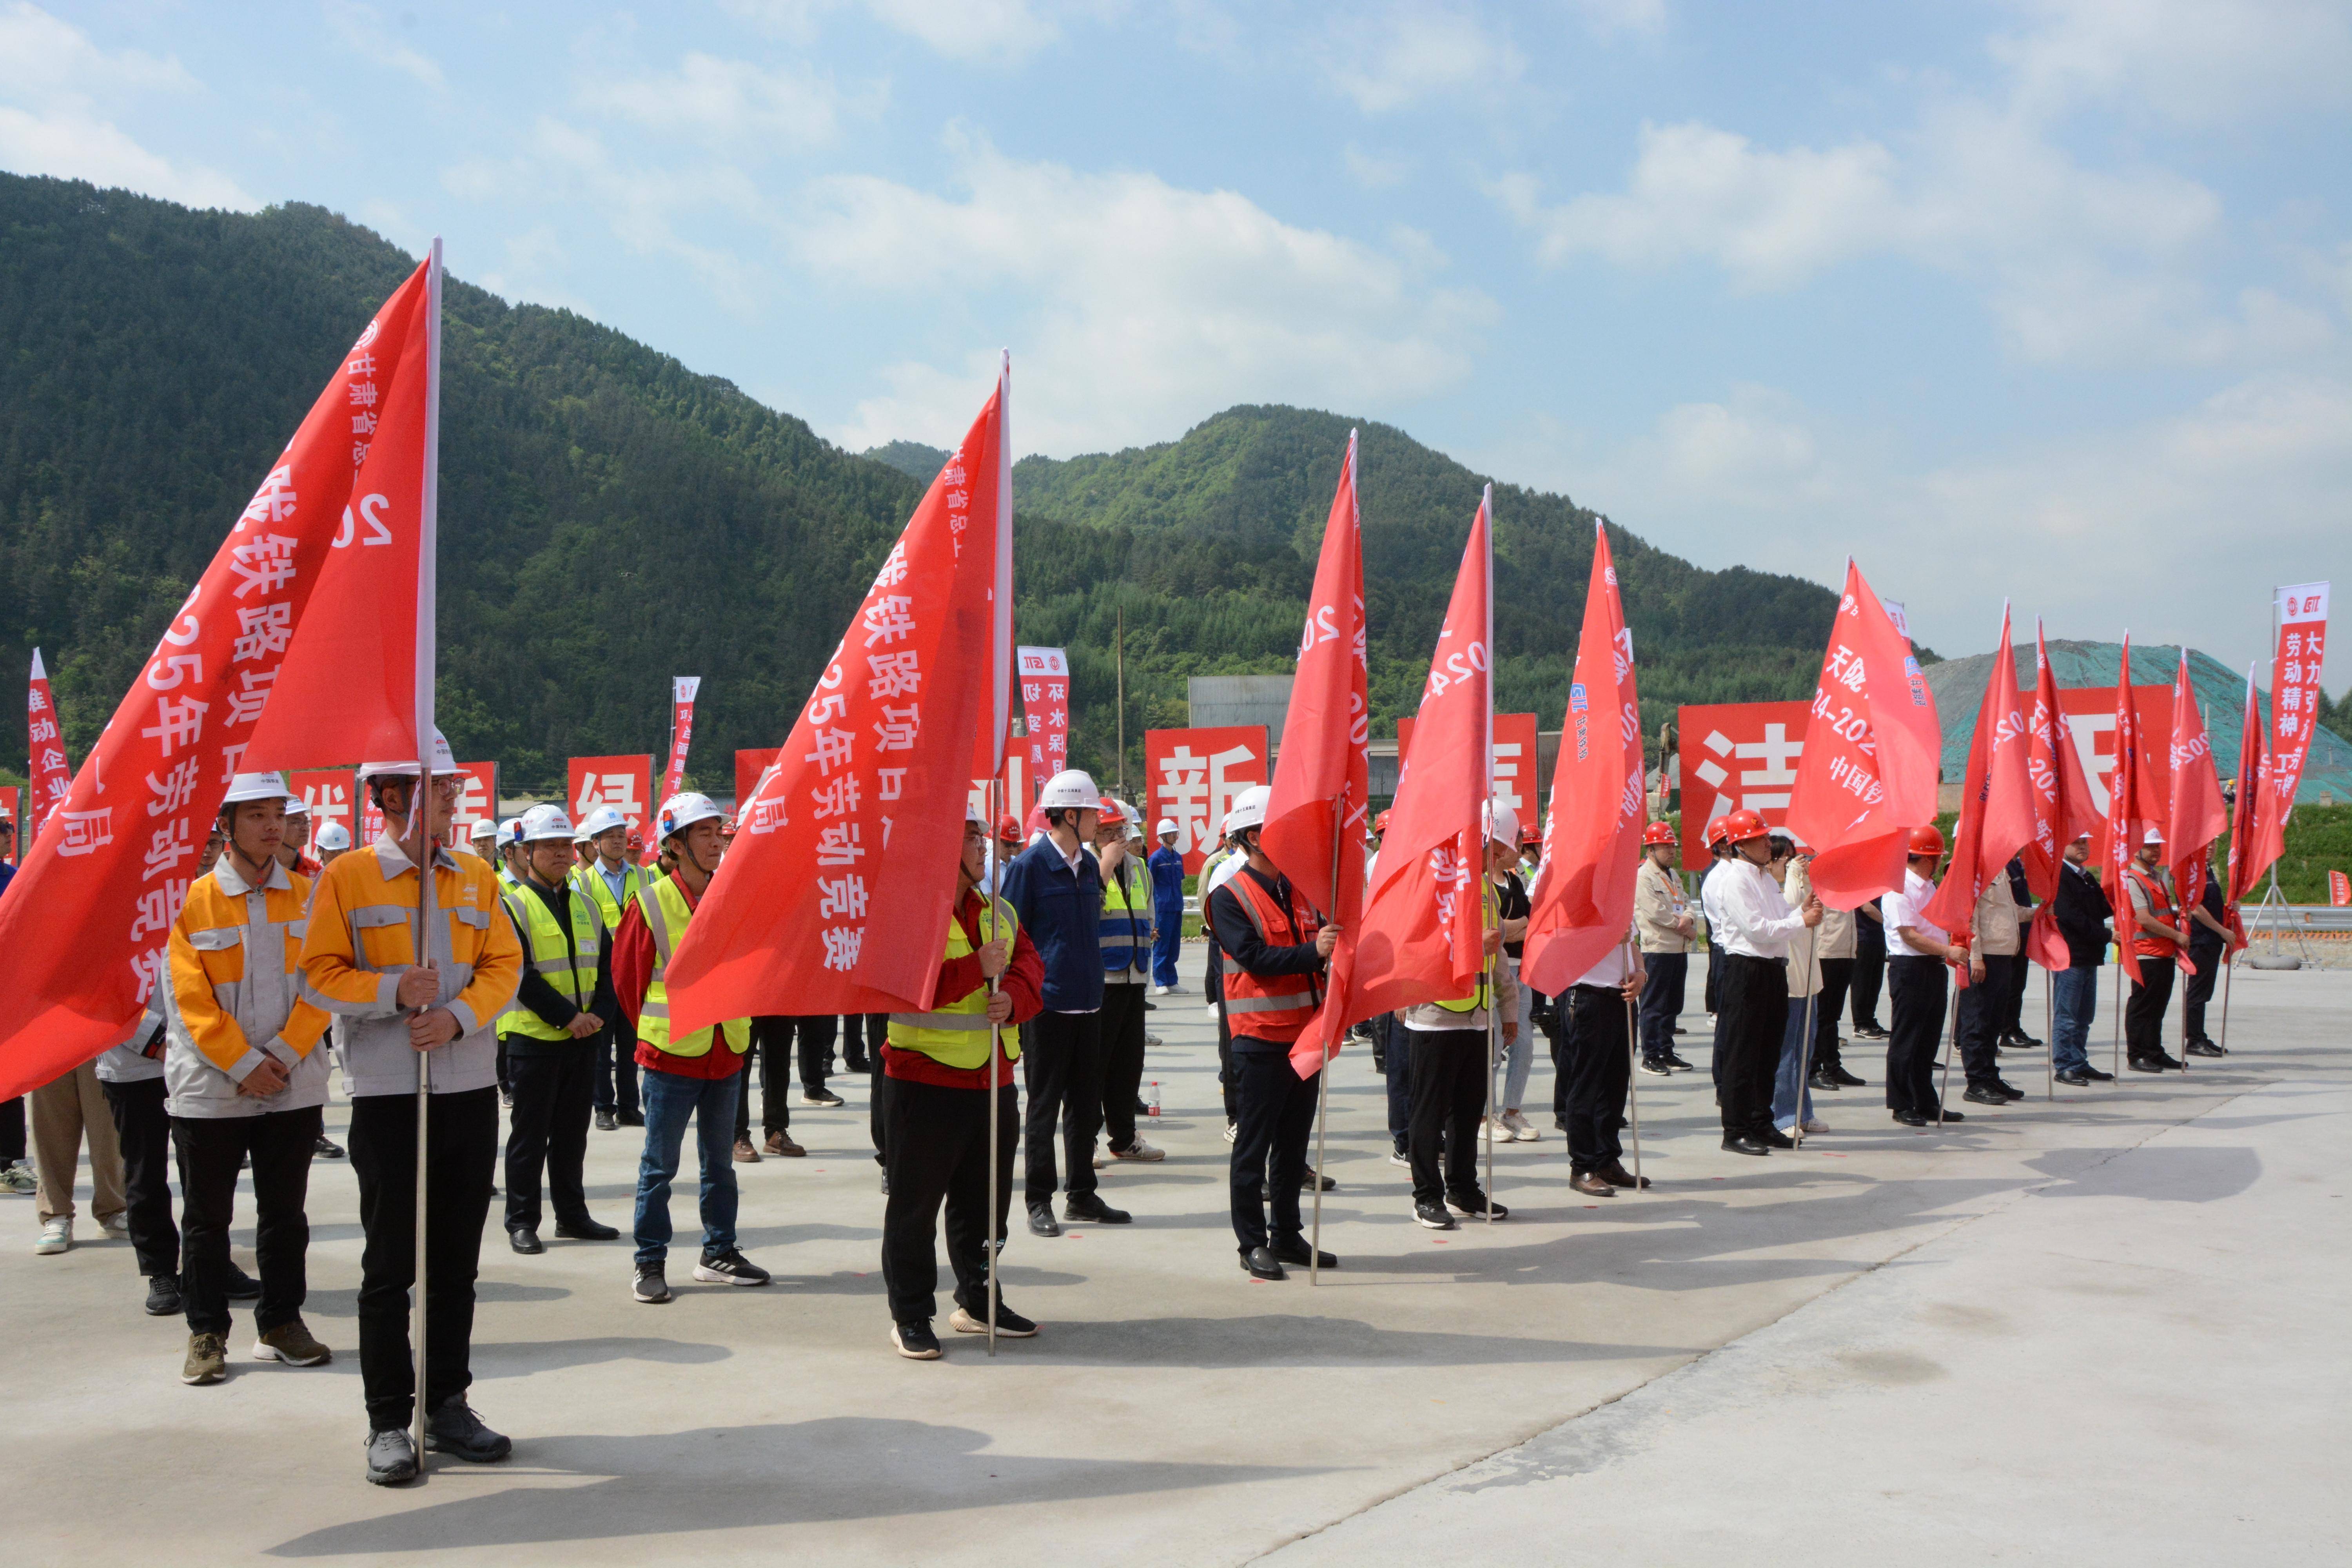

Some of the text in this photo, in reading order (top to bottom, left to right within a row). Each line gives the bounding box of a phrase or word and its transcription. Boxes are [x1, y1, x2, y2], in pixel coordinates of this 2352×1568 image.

[1826, 645, 1870, 699] 天陇
[2278, 632, 2303, 737] 劳动精神
[1157, 744, 1257, 856] 新
